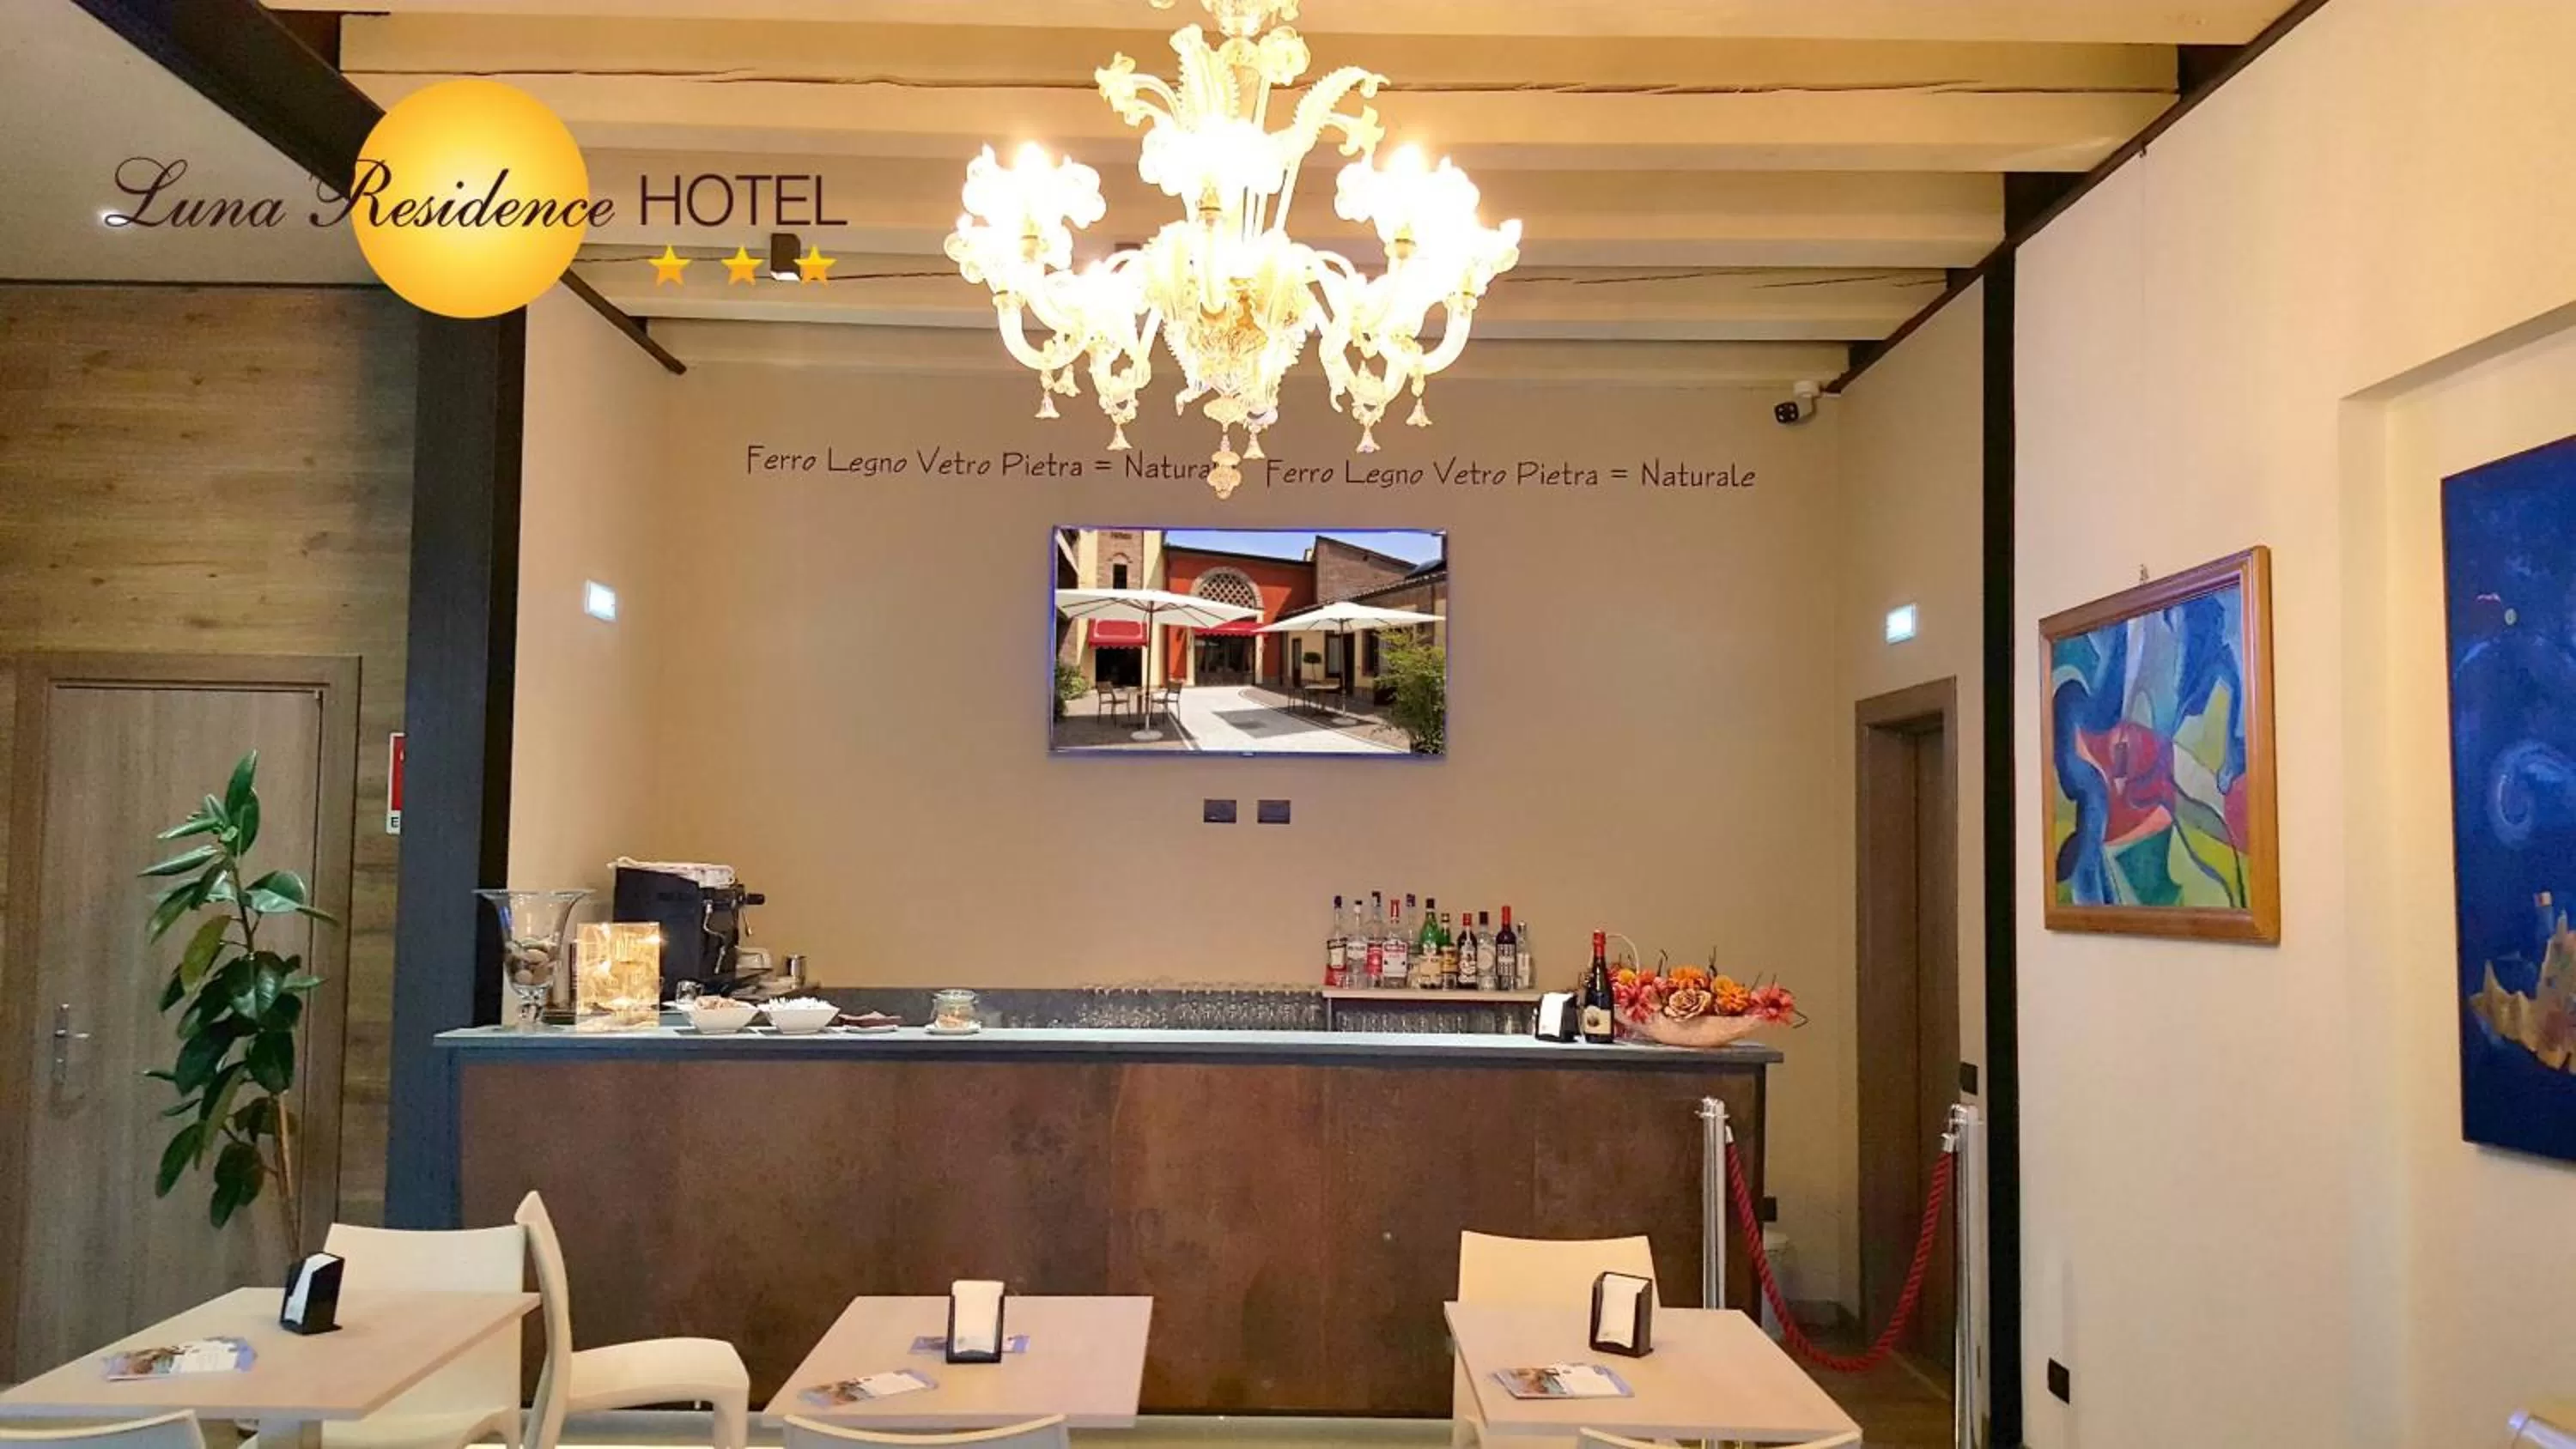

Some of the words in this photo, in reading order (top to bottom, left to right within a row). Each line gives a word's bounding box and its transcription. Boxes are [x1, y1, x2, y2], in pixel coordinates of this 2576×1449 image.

[748, 445, 817, 475] Ferro
[827, 446, 908, 476] Legno
[916, 446, 990, 476] Vetro
[1001, 452, 1083, 478] Pietra
[1125, 449, 1235, 480] Natura
[1267, 459, 1334, 488] Ferro
[1345, 460, 1424, 488] Legno
[1433, 457, 1507, 487] Vetro
[1517, 461, 1598, 487] Pietra
[1641, 458, 1757, 488] Naturale
